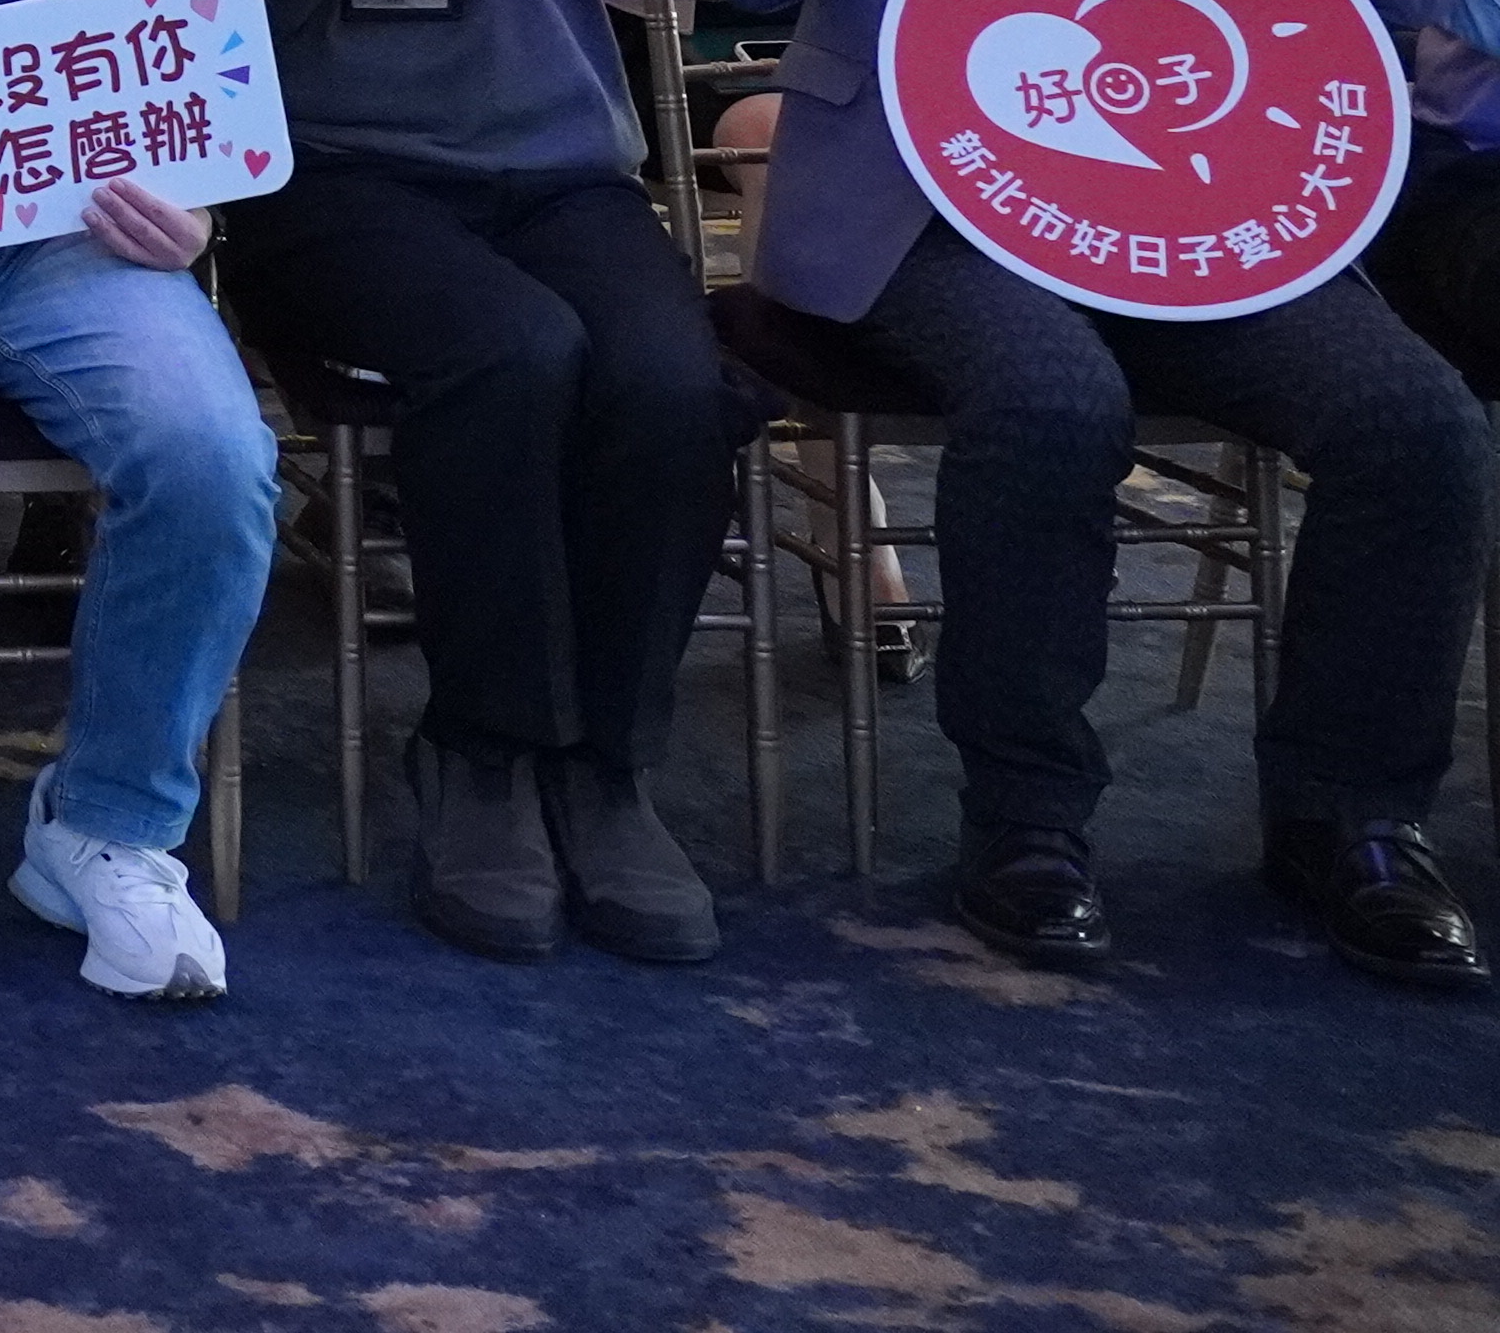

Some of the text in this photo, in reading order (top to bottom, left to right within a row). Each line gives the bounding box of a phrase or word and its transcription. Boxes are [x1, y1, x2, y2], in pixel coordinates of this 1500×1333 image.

[940, 80, 1368, 278] 新北市好日子愛心大平台
